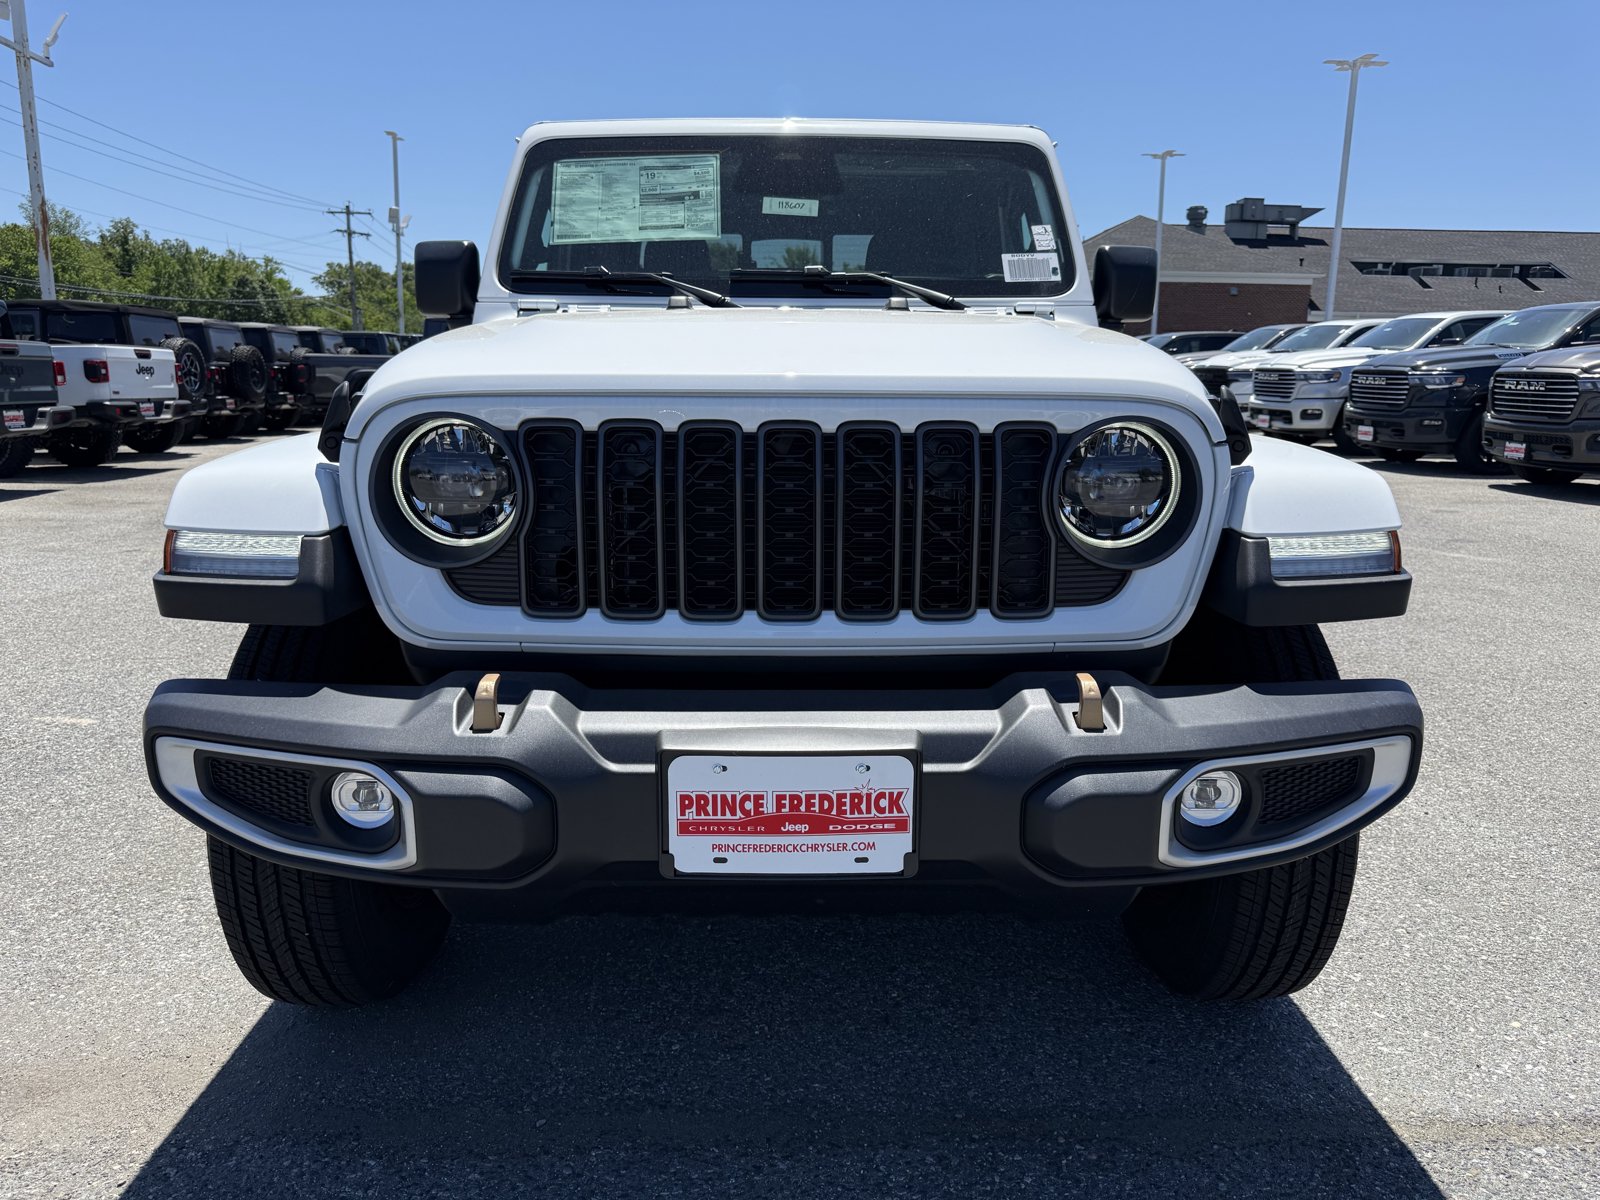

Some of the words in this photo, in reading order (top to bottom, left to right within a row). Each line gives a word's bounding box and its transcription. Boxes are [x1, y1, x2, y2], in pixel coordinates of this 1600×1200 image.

[645, 172, 656, 180] 19
[136, 363, 155, 377] Jeep
[1357, 376, 1387, 385] RAM
[1504, 380, 1546, 391] RAM
[678, 792, 767, 818] PRINCE
[773, 789, 906, 816] FREDERICK
[780, 821, 809, 833] Jeep
[828, 823, 896, 831] DODGE
[711, 841, 876, 853] PRINCEFREDERICKCHRYSLER.COM
